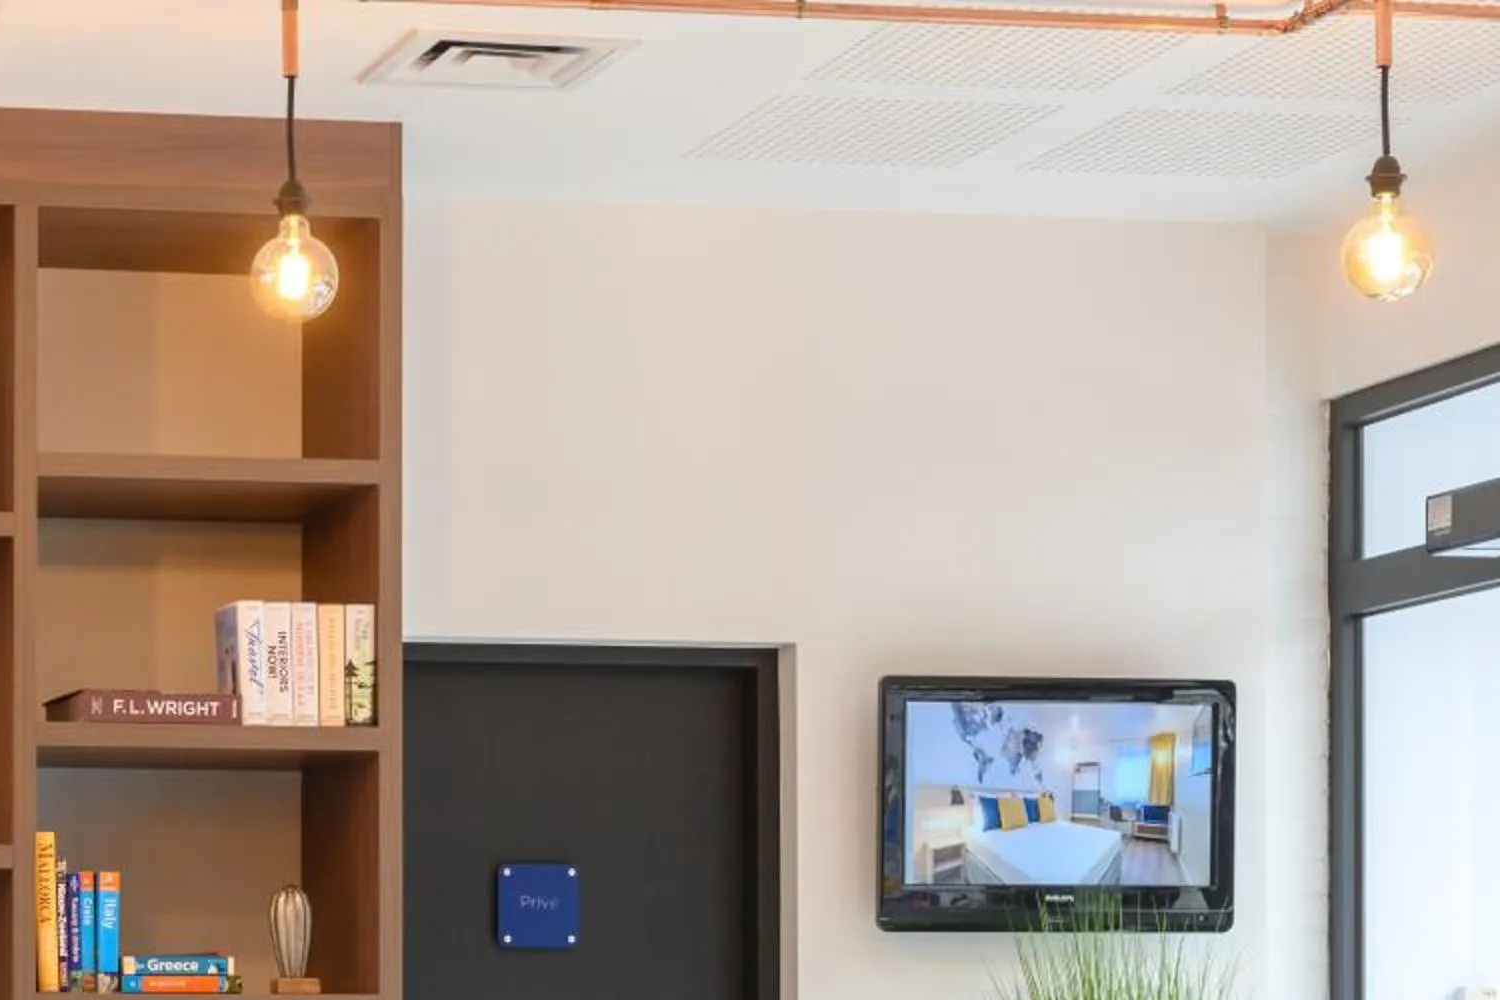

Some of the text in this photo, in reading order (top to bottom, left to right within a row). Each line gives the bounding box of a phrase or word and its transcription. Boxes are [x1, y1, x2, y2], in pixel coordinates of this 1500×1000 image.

[277, 631, 289, 693] INTERIORS
[147, 700, 222, 717] WRIGHT
[101, 899, 117, 929] Italy
[147, 959, 199, 972] Greece
